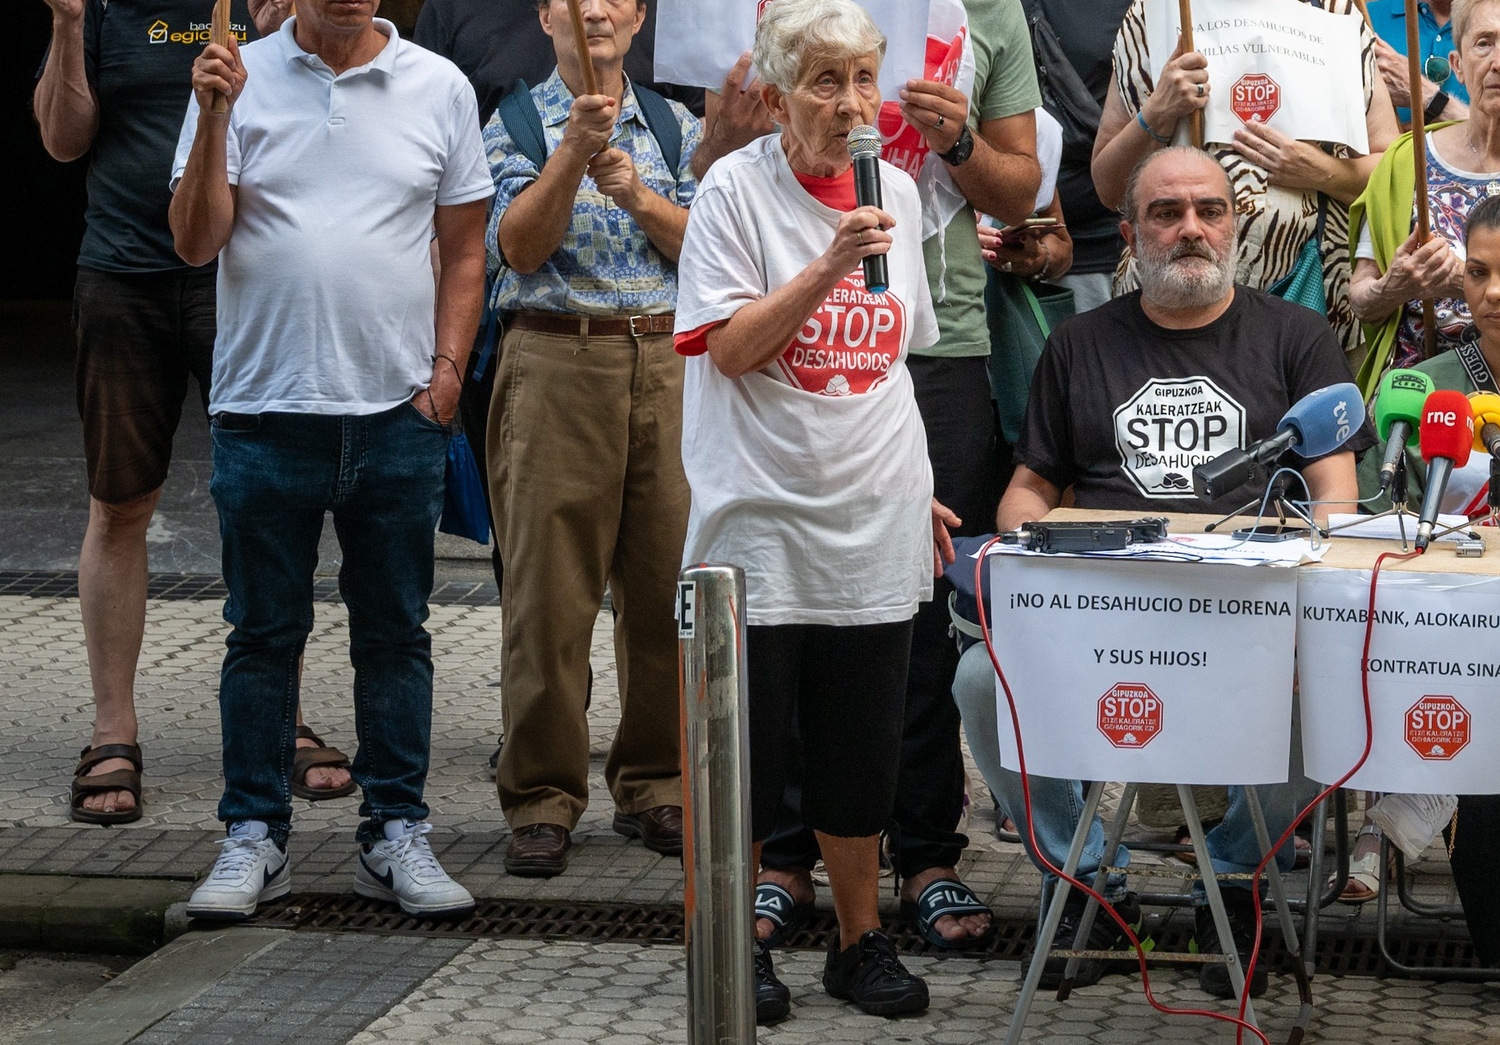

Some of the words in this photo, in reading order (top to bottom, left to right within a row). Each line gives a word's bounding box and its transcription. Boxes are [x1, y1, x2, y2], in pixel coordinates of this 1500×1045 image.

[1196, 23, 1208, 33] A
[1207, 19, 1231, 31] LOS
[1234, 18, 1308, 40] DESAHUCIOS
[1308, 34, 1325, 45] DE
[1197, 43, 1240, 57] MILIAS
[1243, 43, 1326, 67] VULNERABLES
[1235, 84, 1276, 102] STOP
[791, 347, 891, 372] DESAHUCIOS
[1459, 343, 1489, 383] GUESS
[1154, 385, 1204, 398] GIPUZKOA
[1136, 400, 1222, 417] KALERATZEAK
[1427, 410, 1457, 427] rne
[1333, 400, 1350, 442] tve
[1127, 414, 1228, 452] STOP
[1010, 592, 1045, 610] ¡NO
[1049, 593, 1072, 609] AL
[1077, 595, 1184, 613] DESAHUCIO
[1189, 598, 1212, 614] DE
[1218, 599, 1292, 616] LORENA
[1303, 605, 1410, 628] KUTXABANK,
[1414, 611, 1500, 629] ALOKAIRU
[1093, 648, 1105, 664] Y
[1109, 648, 1144, 665] SUS
[1149, 650, 1208, 667] HIJOS!
[1112, 689, 1149, 698] GIPUZKOA
[1104, 696, 1157, 718] STOP
[1419, 702, 1456, 711] GIPUZKOA
[1411, 709, 1465, 730] STOP
[927, 889, 981, 909] FILA
